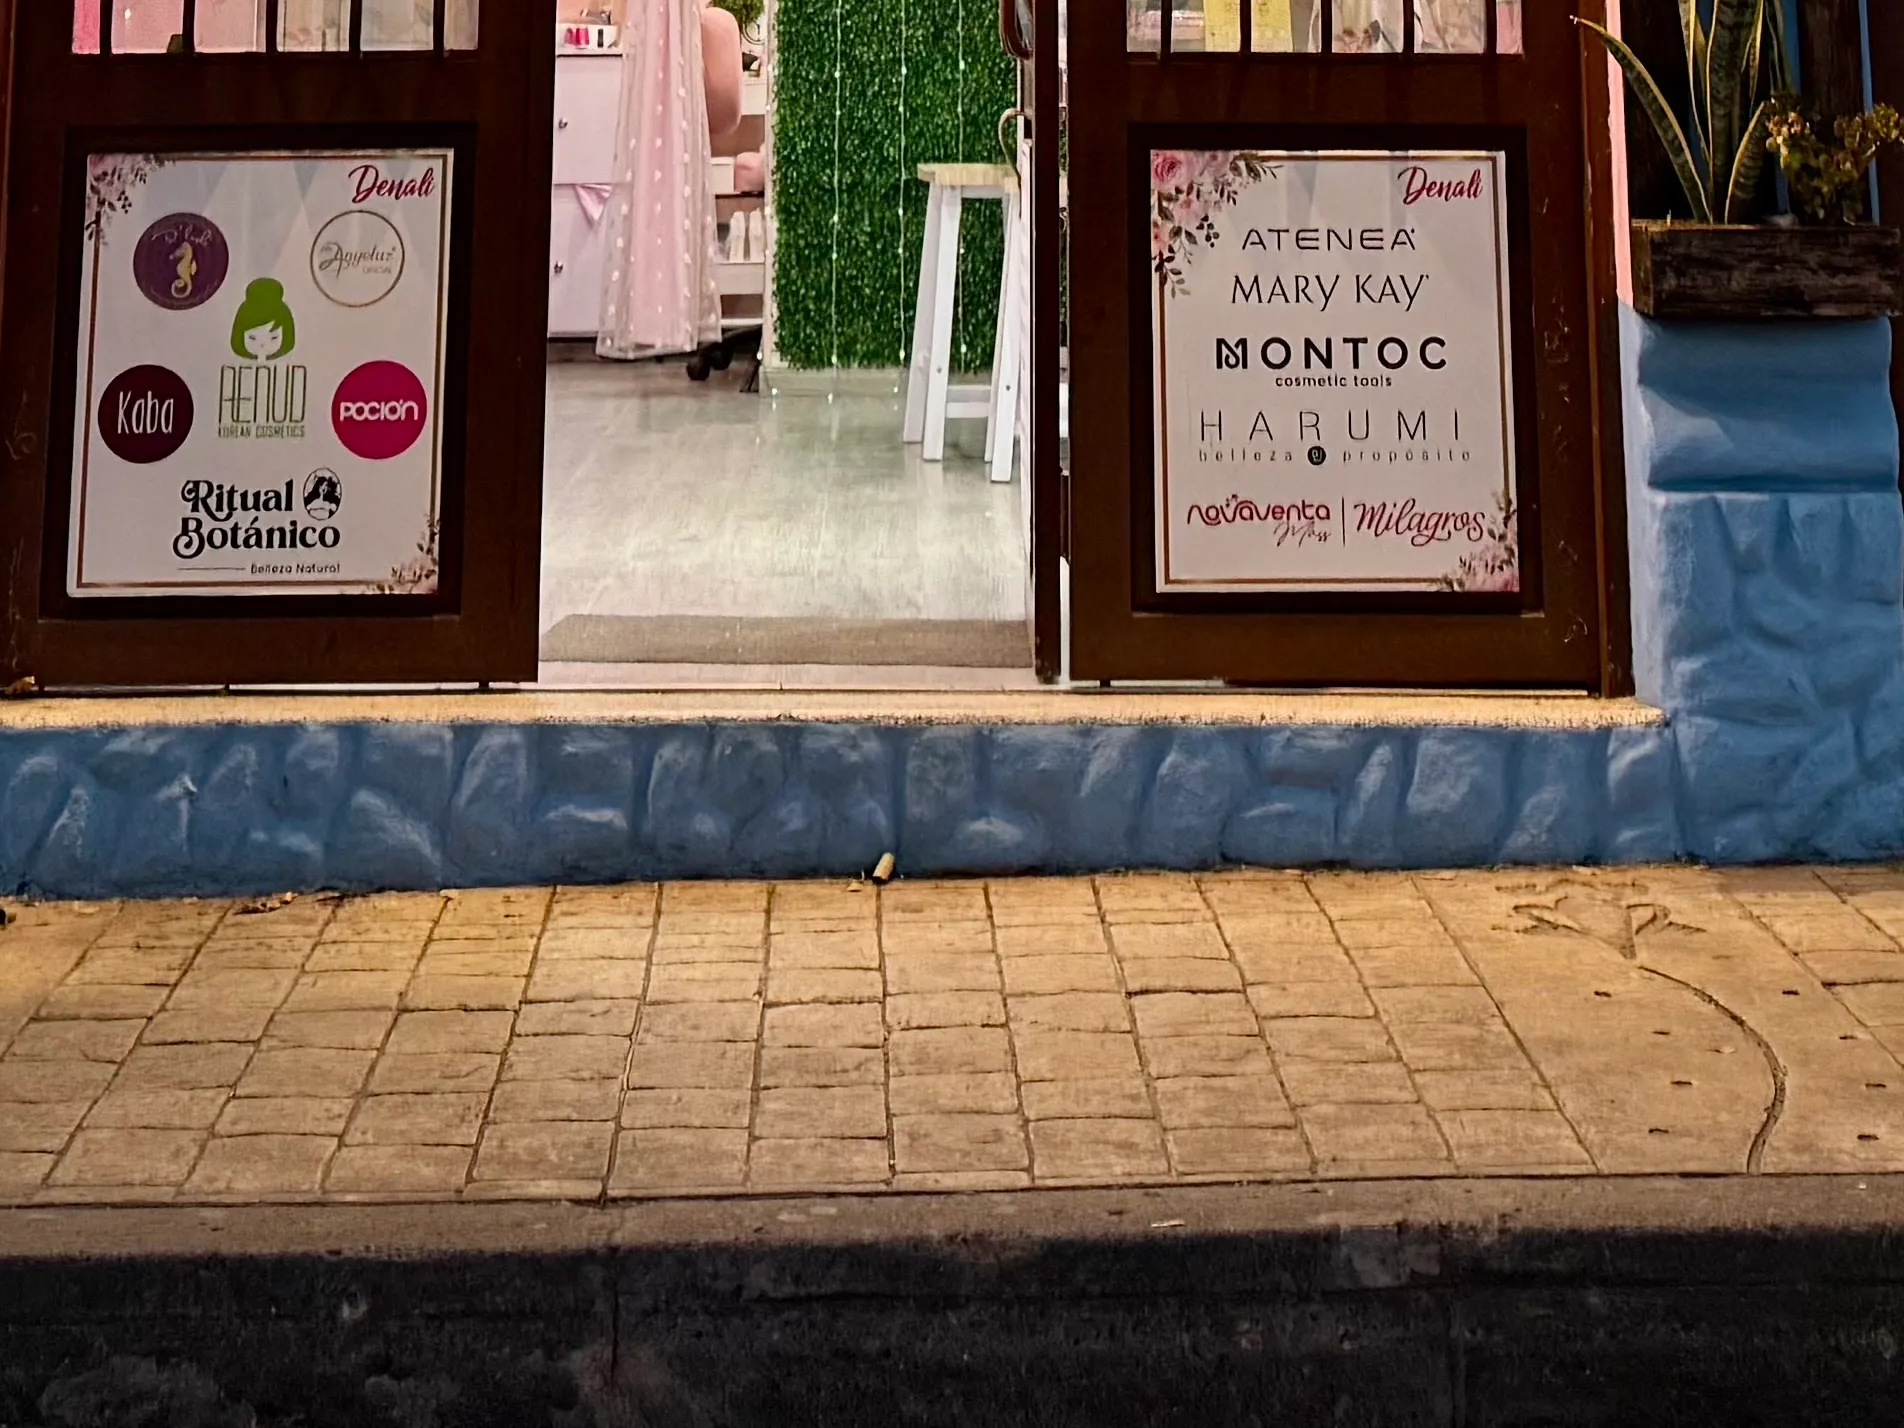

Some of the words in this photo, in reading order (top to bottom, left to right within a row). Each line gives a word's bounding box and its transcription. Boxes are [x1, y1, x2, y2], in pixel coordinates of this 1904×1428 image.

[348, 163, 435, 204] Denali
[1398, 165, 1484, 206] Denali
[1241, 226, 1417, 252] ATENEA
[1231, 273, 1340, 312] MARY
[1354, 273, 1428, 312] KAY
[1215, 337, 1448, 371] MONTOC
[1275, 374, 1348, 387] cosmetic
[1353, 374, 1393, 387] tools
[116, 390, 175, 435] Kaba
[218, 425, 251, 438] KOREAN
[255, 424, 305, 438] COSMETICS
[1200, 409, 1459, 442] HARUMI
[180, 477, 295, 521] Ritual
[172, 516, 341, 560] Botánico
[1353, 497, 1487, 547] Milagros
[296, 562, 340, 575] Natural
